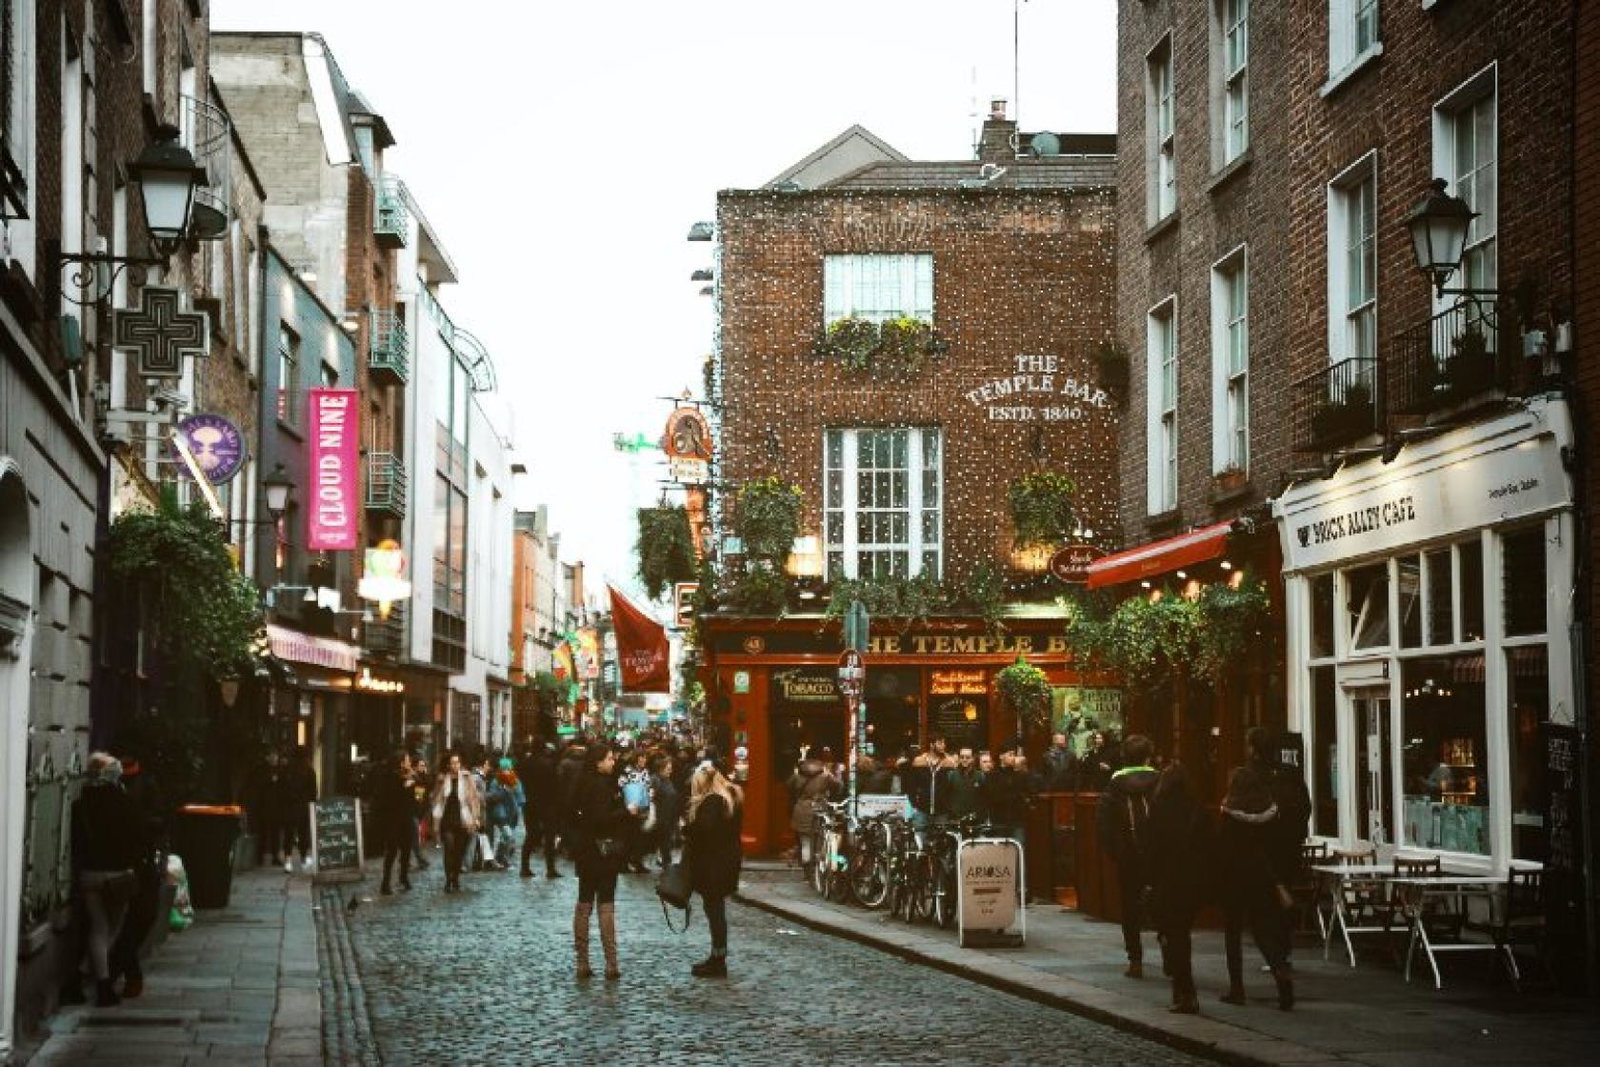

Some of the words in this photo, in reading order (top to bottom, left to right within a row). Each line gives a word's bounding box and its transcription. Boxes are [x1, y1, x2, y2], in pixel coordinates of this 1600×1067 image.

[1014, 354, 1058, 373] THE
[965, 374, 1054, 406] TEMPLE
[1060, 378, 1109, 408] BAR
[319, 396, 349, 448] NINE
[1040, 406, 1082, 421] 1840
[319, 453, 347, 527] CLOUD
[1312, 516, 1346, 544] BRICK
[1347, 505, 1381, 536] ALLEY
[866, 635, 901, 653] HE
[912, 635, 1033, 653] TEMPLE
[965, 865, 1011, 878] ARIOSA
